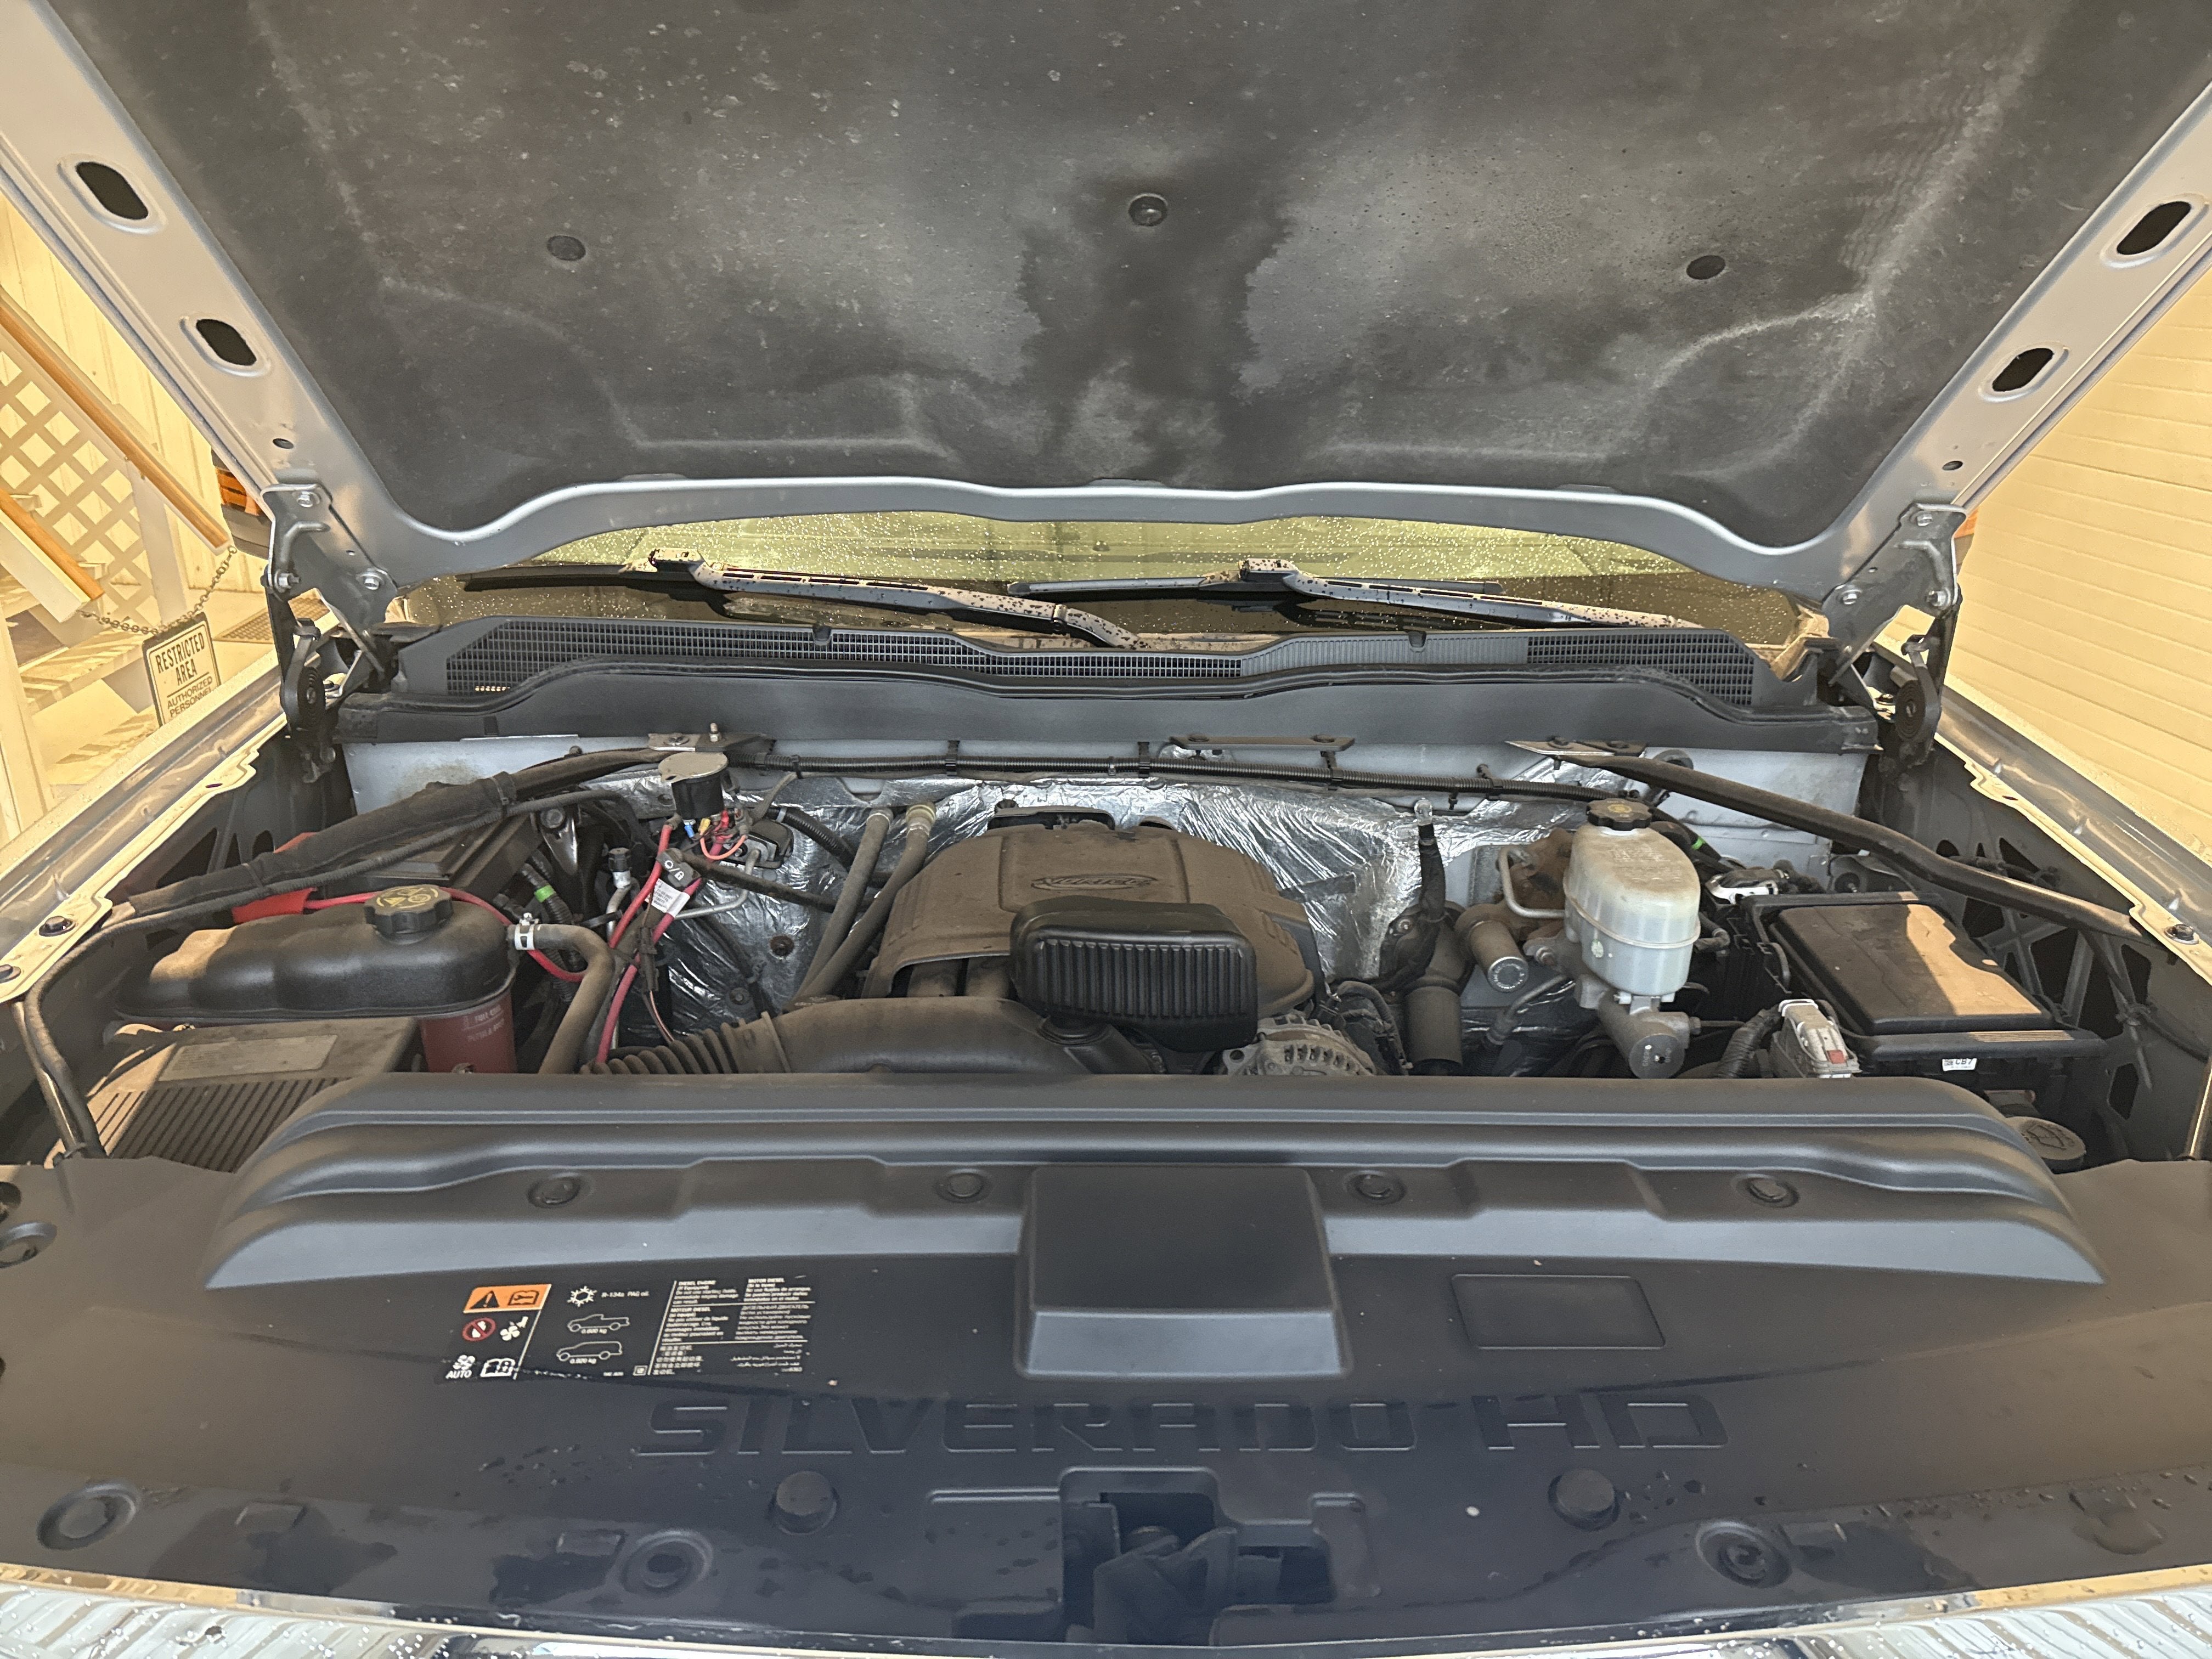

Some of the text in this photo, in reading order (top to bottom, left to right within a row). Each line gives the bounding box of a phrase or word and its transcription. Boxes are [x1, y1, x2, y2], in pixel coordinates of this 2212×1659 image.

[155, 632, 205, 674] RESTRICTED
[176, 658, 198, 686] AREA
[167, 676, 213, 709] AUTHORIZED
[445, 1370, 472, 1379] AUTO
[631, 1395, 1729, 1457] SILVERADO HD
